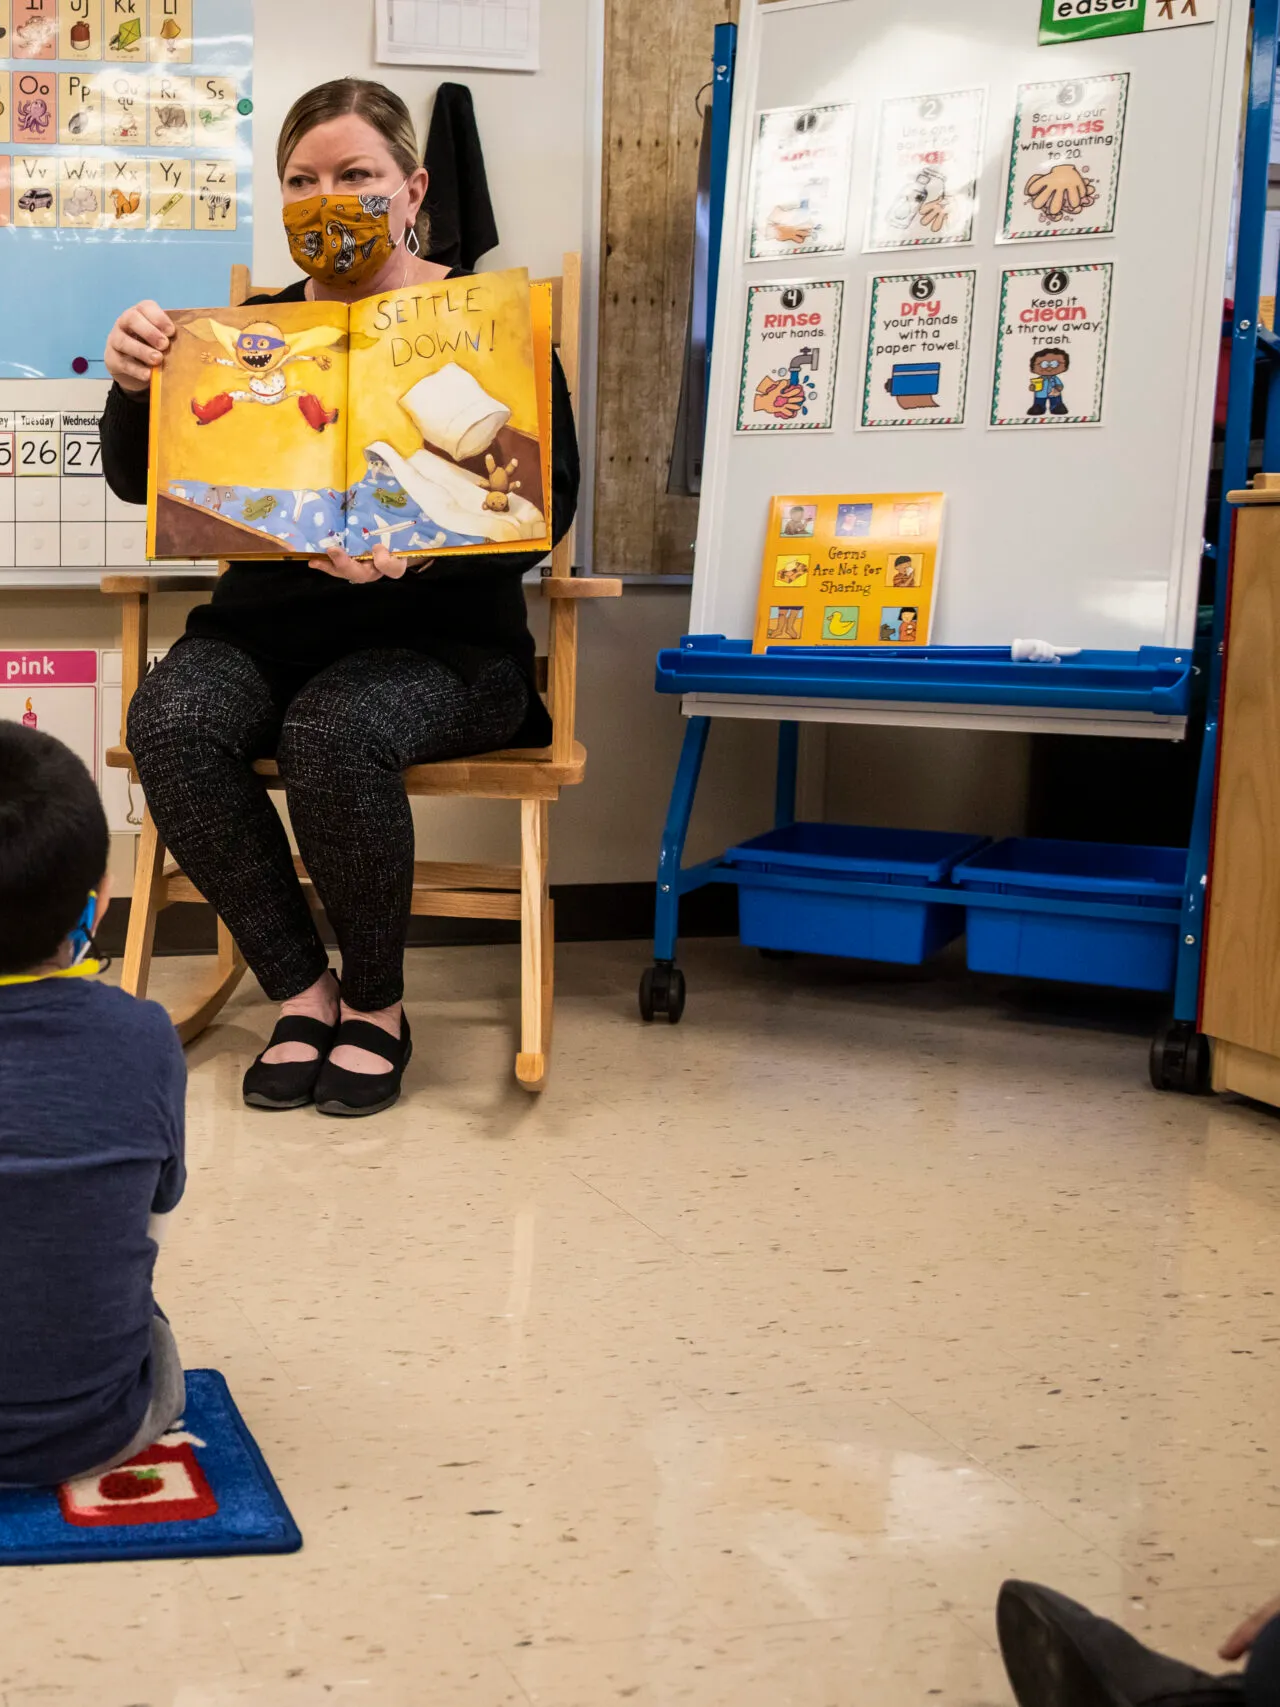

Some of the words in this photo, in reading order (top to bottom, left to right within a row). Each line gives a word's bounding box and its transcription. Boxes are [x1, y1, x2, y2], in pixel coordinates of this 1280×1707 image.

[19, 76, 49, 95] Oo
[70, 77, 90, 102] Pp
[207, 81, 224, 99] Ss
[1021, 141, 1053, 151] while
[1057, 135, 1112, 147] counting
[23, 160, 47, 178] Vv
[64, 161, 97, 179] Ww
[114, 162, 137, 180] Xx
[160, 163, 181, 187] Yy
[206, 164, 226, 183] Zz
[917, 281, 928, 297] 5
[1049, 273, 1060, 291] 6
[788, 292, 797, 307] 4
[1032, 299, 1063, 308] Keep
[1067, 296, 1077, 305] it
[373, 287, 481, 331] SETTLE
[901, 300, 941, 316] Dry
[1020, 307, 1086, 322] clean
[764, 312, 821, 328] Rinse
[884, 318, 914, 329] your
[920, 315, 957, 326] hands
[1006, 325, 1012, 334] &
[1018, 324, 1057, 333] throw
[1063, 322, 1100, 332] away
[762, 330, 787, 341] your
[790, 329, 826, 337] hands.
[899, 330, 927, 339] with
[932, 329, 940, 338] a
[391, 320, 496, 367] DOWN!
[877, 343, 916, 355] paper
[63, 414, 100, 426] Wednesda
[22, 440, 57, 464] 26
[67, 441, 100, 466] 27
[828, 547, 866, 560] Germs
[813, 565, 834, 576] Are
[838, 564, 859, 576] Not
[863, 565, 882, 576] for
[820, 581, 871, 596] Sharing
[7, 657, 54, 679] pink
